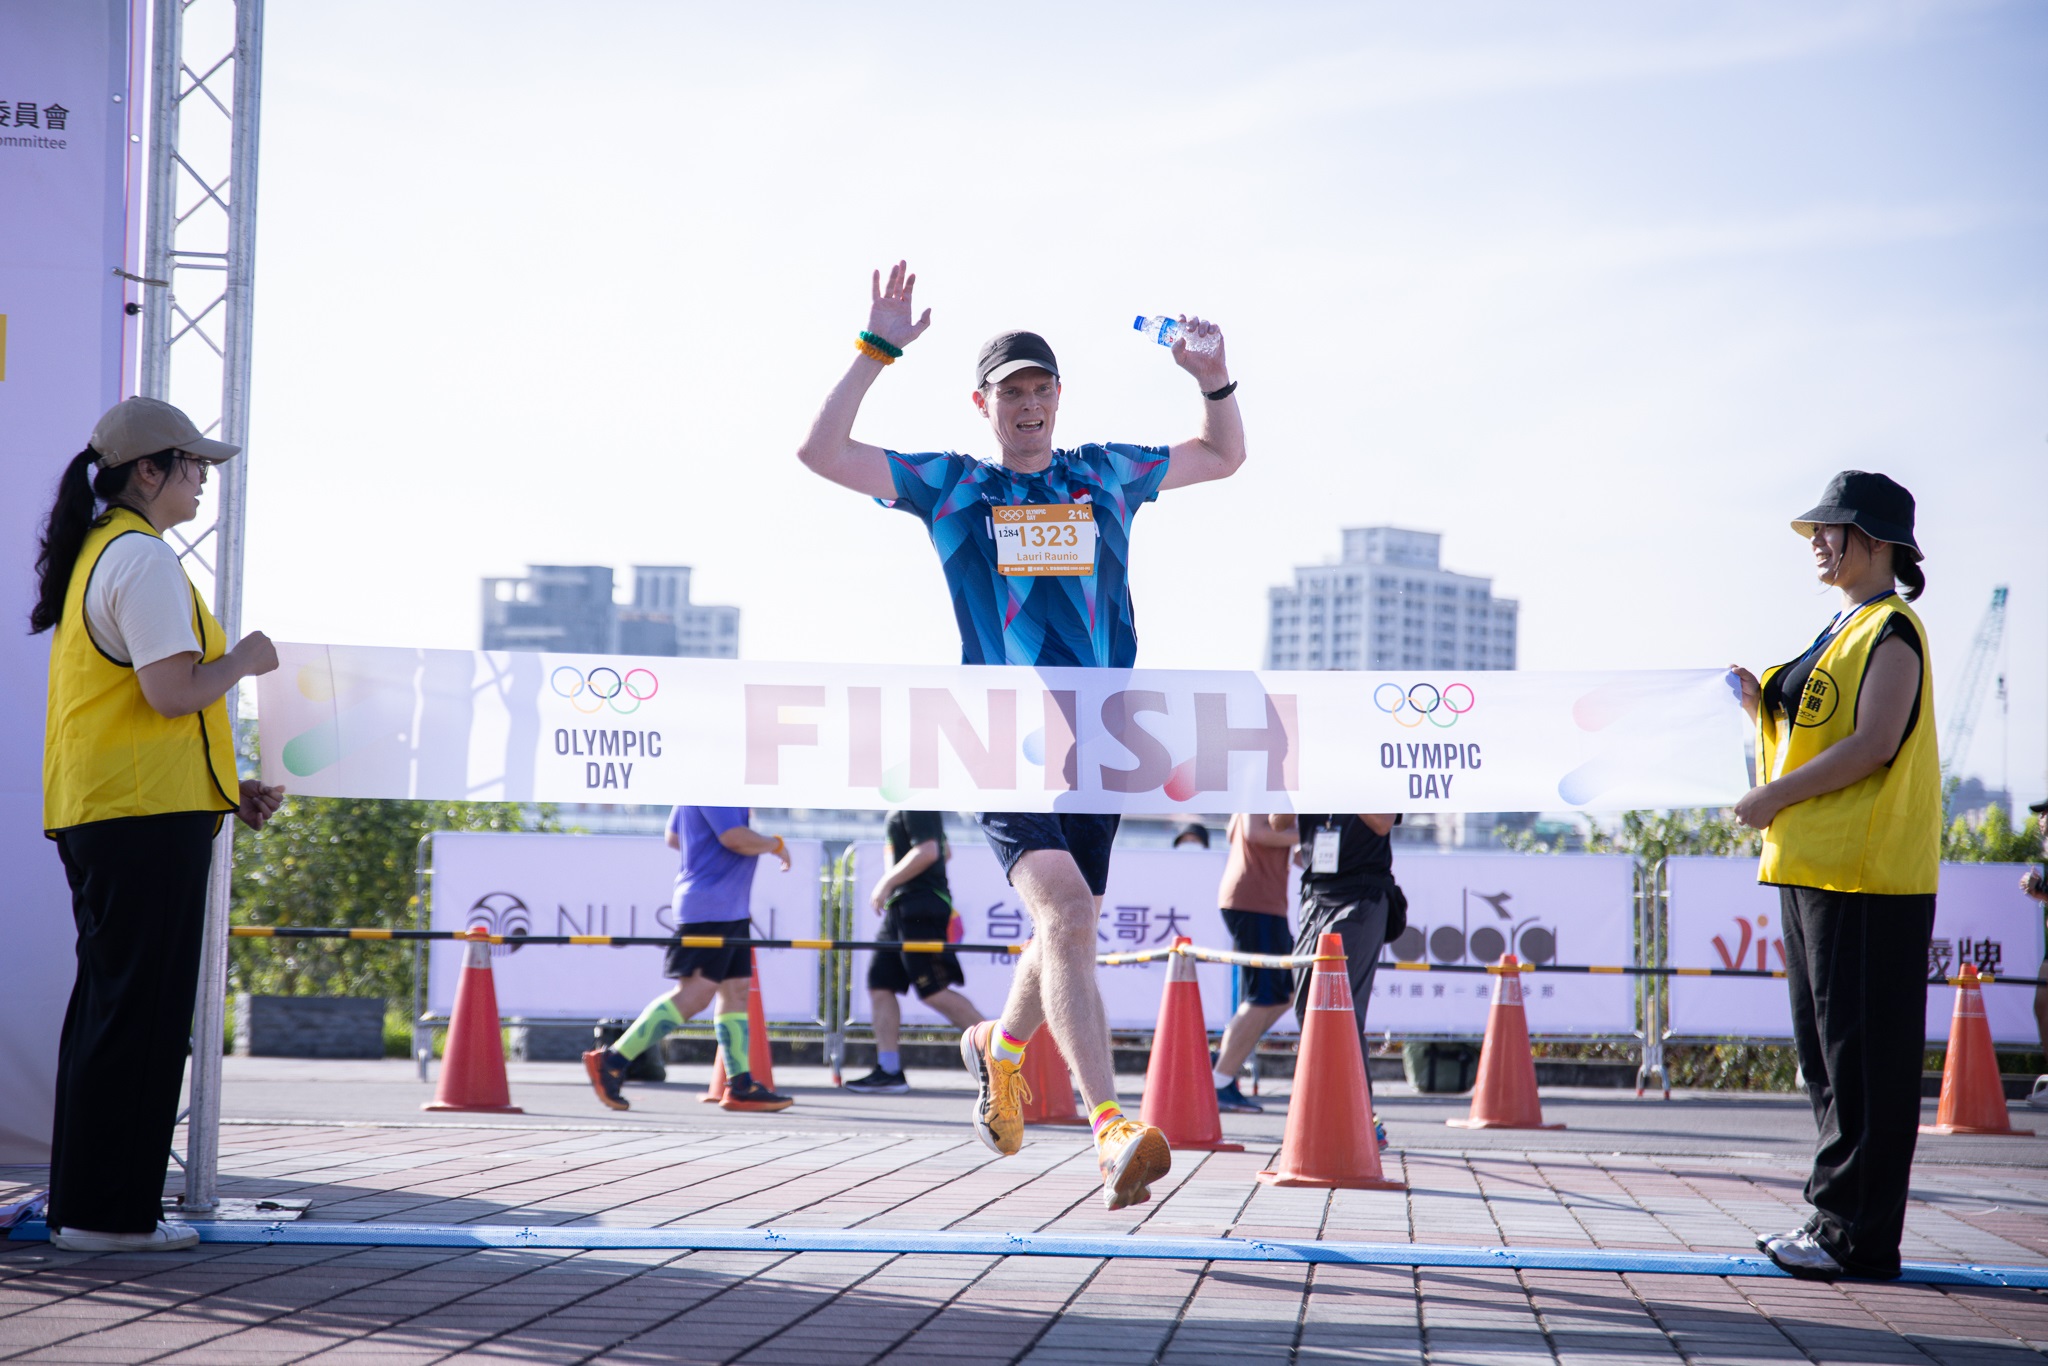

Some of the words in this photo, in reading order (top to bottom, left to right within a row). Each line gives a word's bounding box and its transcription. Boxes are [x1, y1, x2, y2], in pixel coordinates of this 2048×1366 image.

[998, 529, 1019, 538] 1284
[1018, 525, 1078, 547] 1323
[1017, 552, 1042, 561] Lauri
[1044, 552, 1079, 561] Raunio
[554, 728, 662, 758] OLYMPIC
[744, 683, 1300, 794] FINISH
[1380, 742, 1482, 770] OLYMPIC
[586, 762, 633, 789] DAY
[1408, 773, 1454, 800] DAY
[987, 902, 1190, 945] 台哥大
